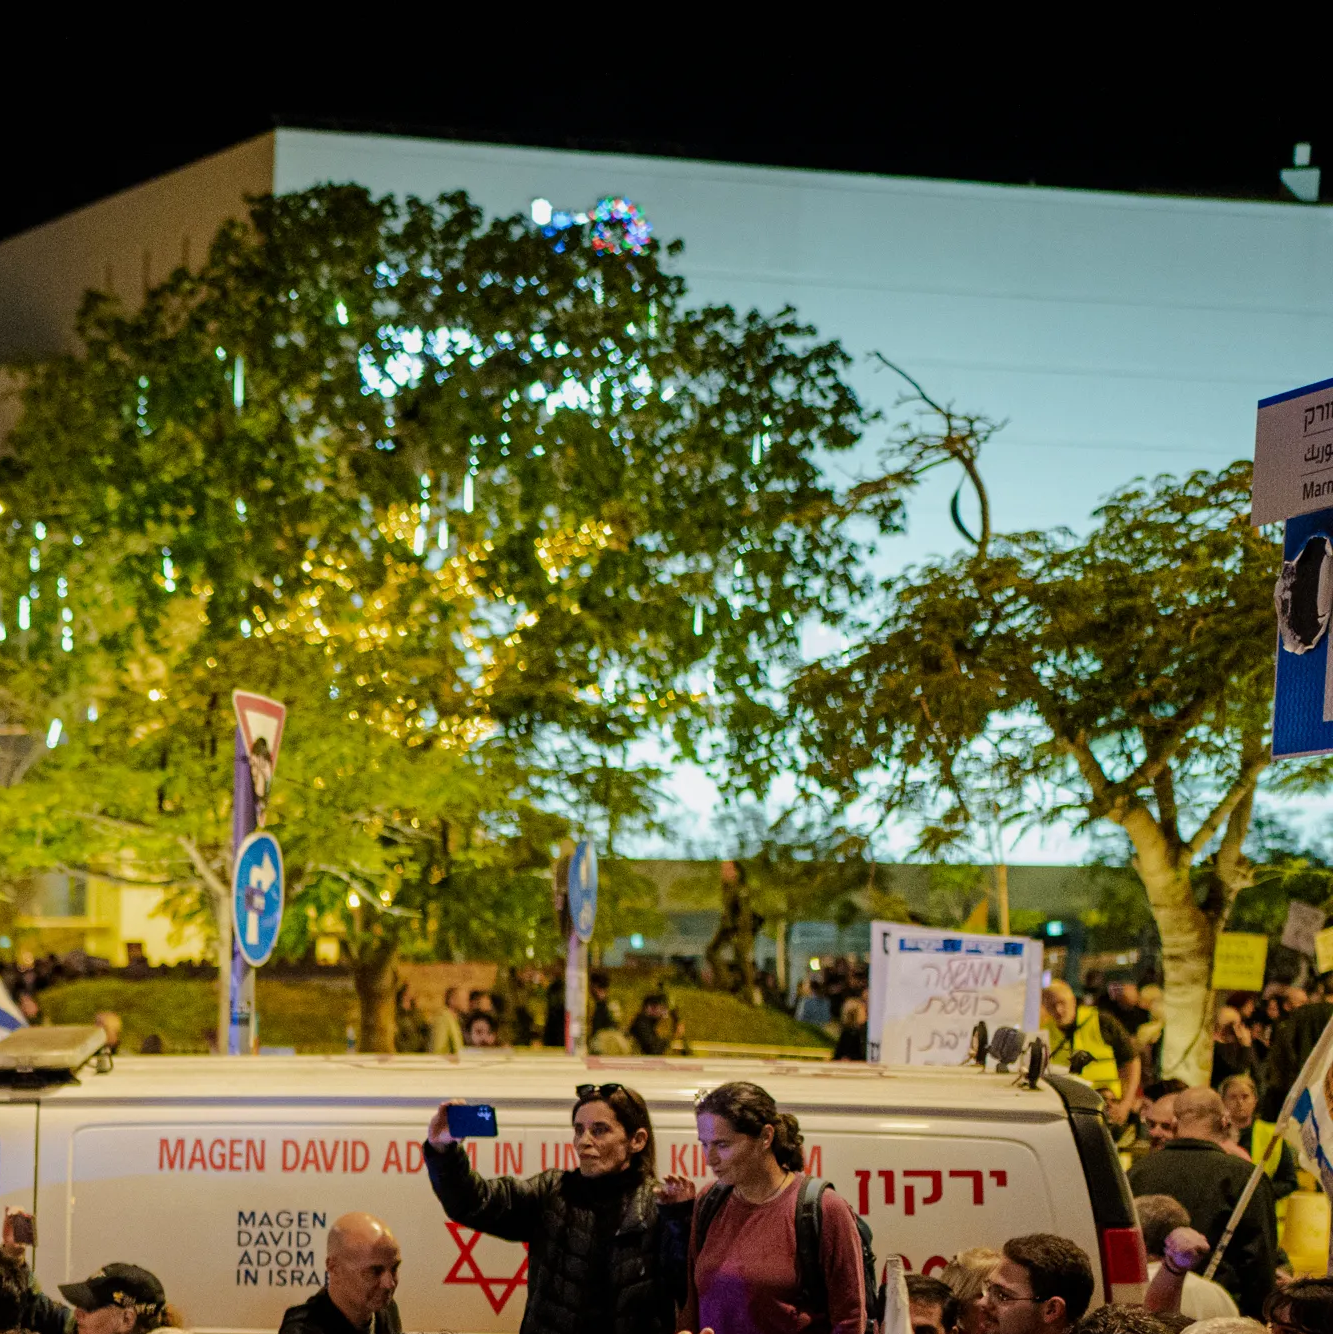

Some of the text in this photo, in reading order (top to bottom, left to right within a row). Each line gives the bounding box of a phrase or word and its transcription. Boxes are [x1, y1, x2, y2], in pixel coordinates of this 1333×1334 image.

[1303, 400, 1333, 433] ורק
[921, 958, 1004, 990] ממשלה
[159, 1138, 265, 1172] MAGEN
[282, 1139, 370, 1173] DAVID
[382, 1141, 478, 1174] ADM
[494, 1142, 524, 1176] IN
[854, 1169, 1009, 1217] ירקון
[237, 1210, 328, 1229] MAGEN
[237, 1230, 312, 1248] DAVID
[238, 1250, 316, 1267] ADOM
[236, 1269, 331, 1288] IN ISRA
